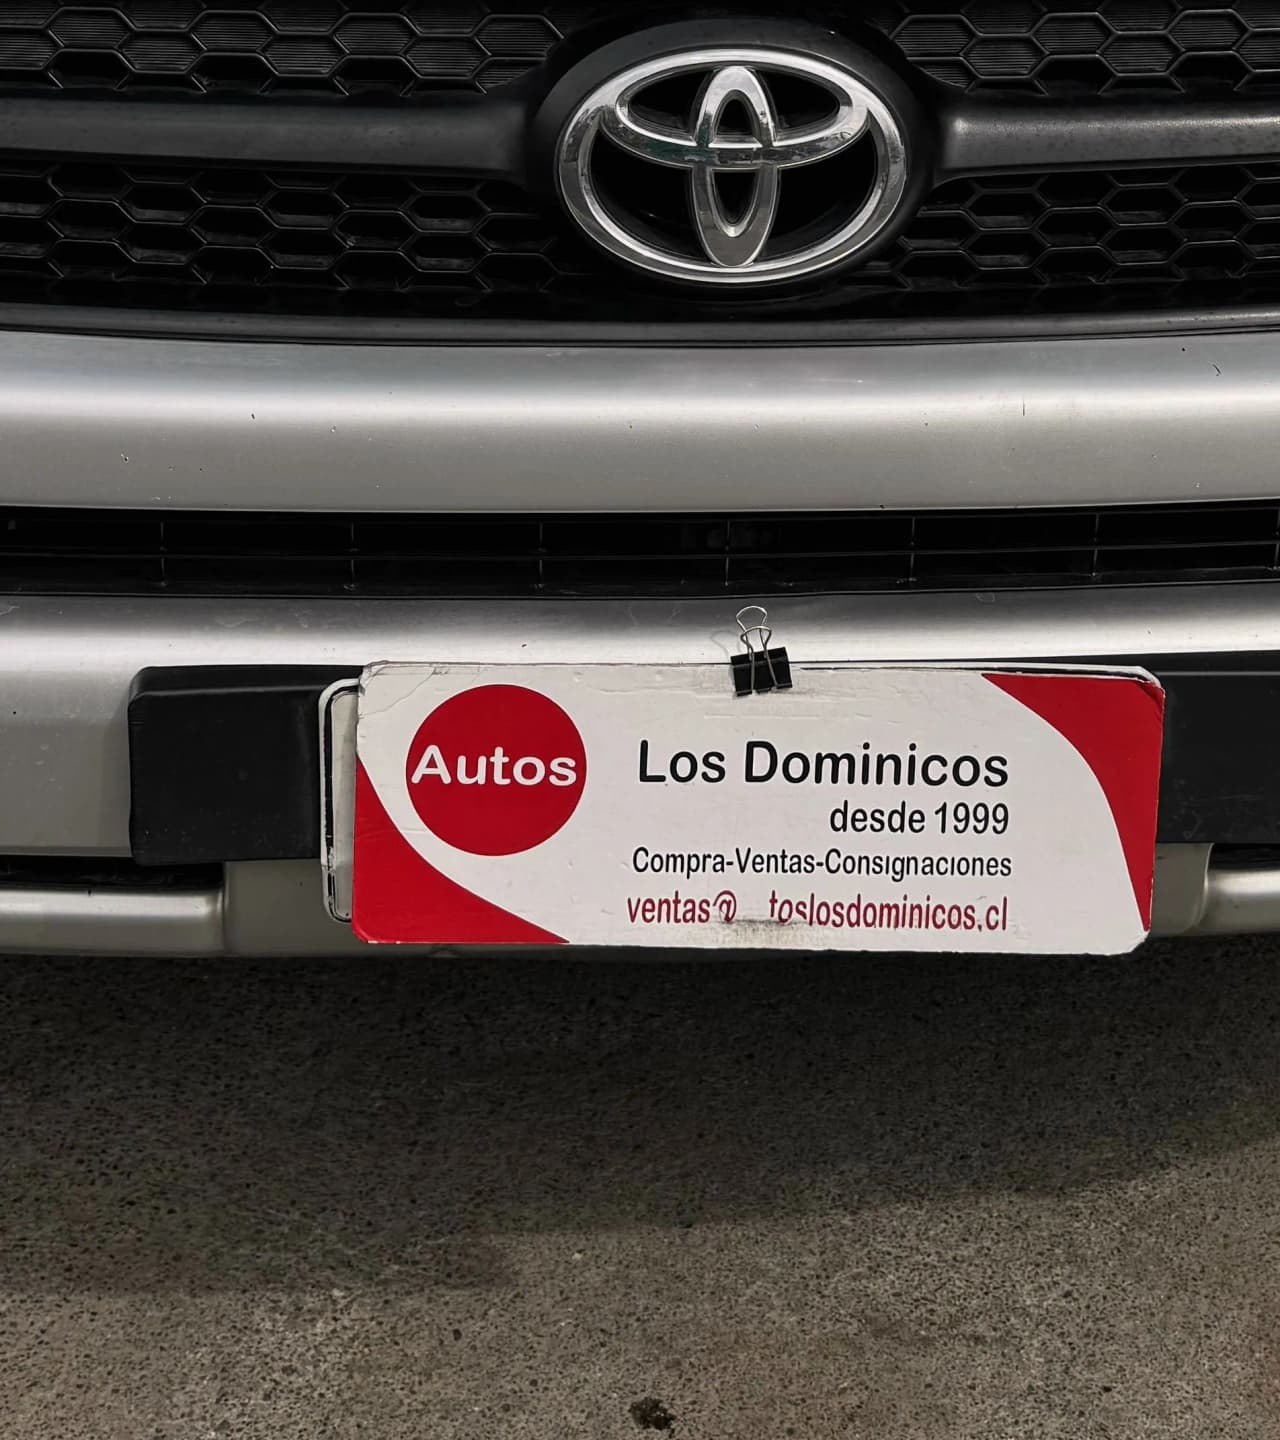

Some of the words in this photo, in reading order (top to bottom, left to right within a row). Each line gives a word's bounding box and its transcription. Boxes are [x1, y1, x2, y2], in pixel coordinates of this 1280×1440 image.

[411, 744, 577, 787] Autos
[638, 739, 726, 784] Los
[744, 740, 1009, 788] Dominicos
[829, 799, 926, 834] desde
[934, 801, 1009, 835] 1999
[632, 846, 1012, 882] Compra-Ventas-Consignaciones
